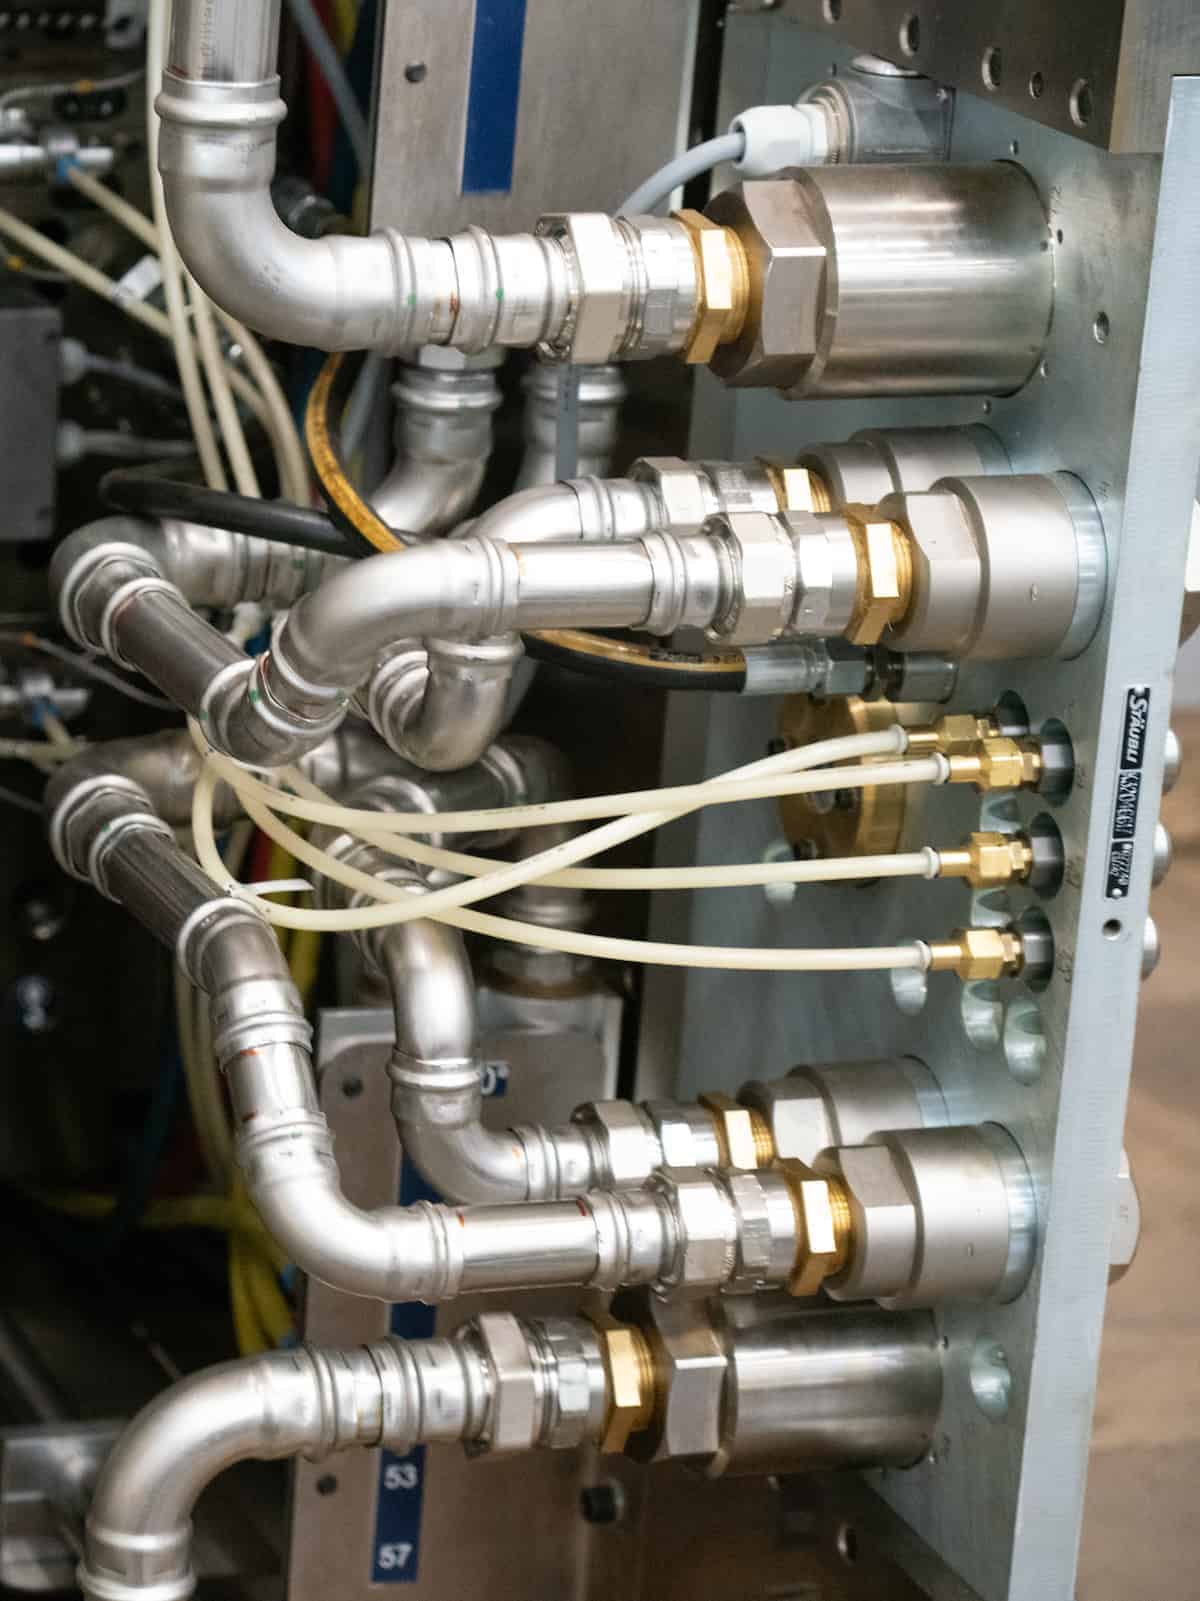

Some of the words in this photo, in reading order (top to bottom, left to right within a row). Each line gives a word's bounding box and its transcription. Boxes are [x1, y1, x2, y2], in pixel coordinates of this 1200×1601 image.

[1126, 695, 1148, 763] STÄUBLI
[384, 1464, 418, 1489] 53
[379, 1543, 412, 1569] 57
